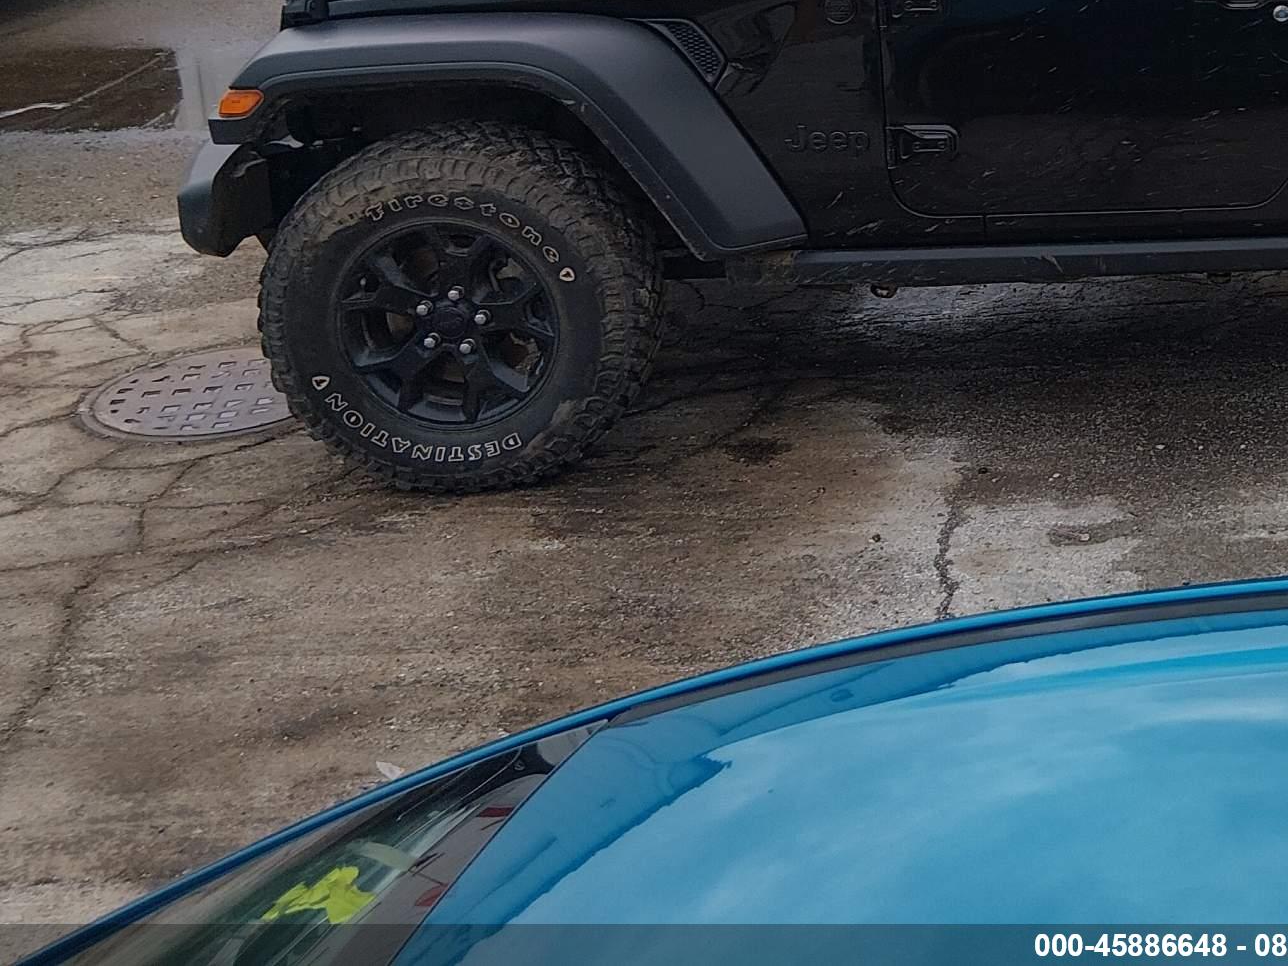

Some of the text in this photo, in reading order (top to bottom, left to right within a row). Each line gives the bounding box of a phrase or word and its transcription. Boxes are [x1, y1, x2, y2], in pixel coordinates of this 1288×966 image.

[784, 125, 869, 159] Jeep
[365, 194, 559, 263] Firestone
[325, 393, 522, 462] DESTINATION
